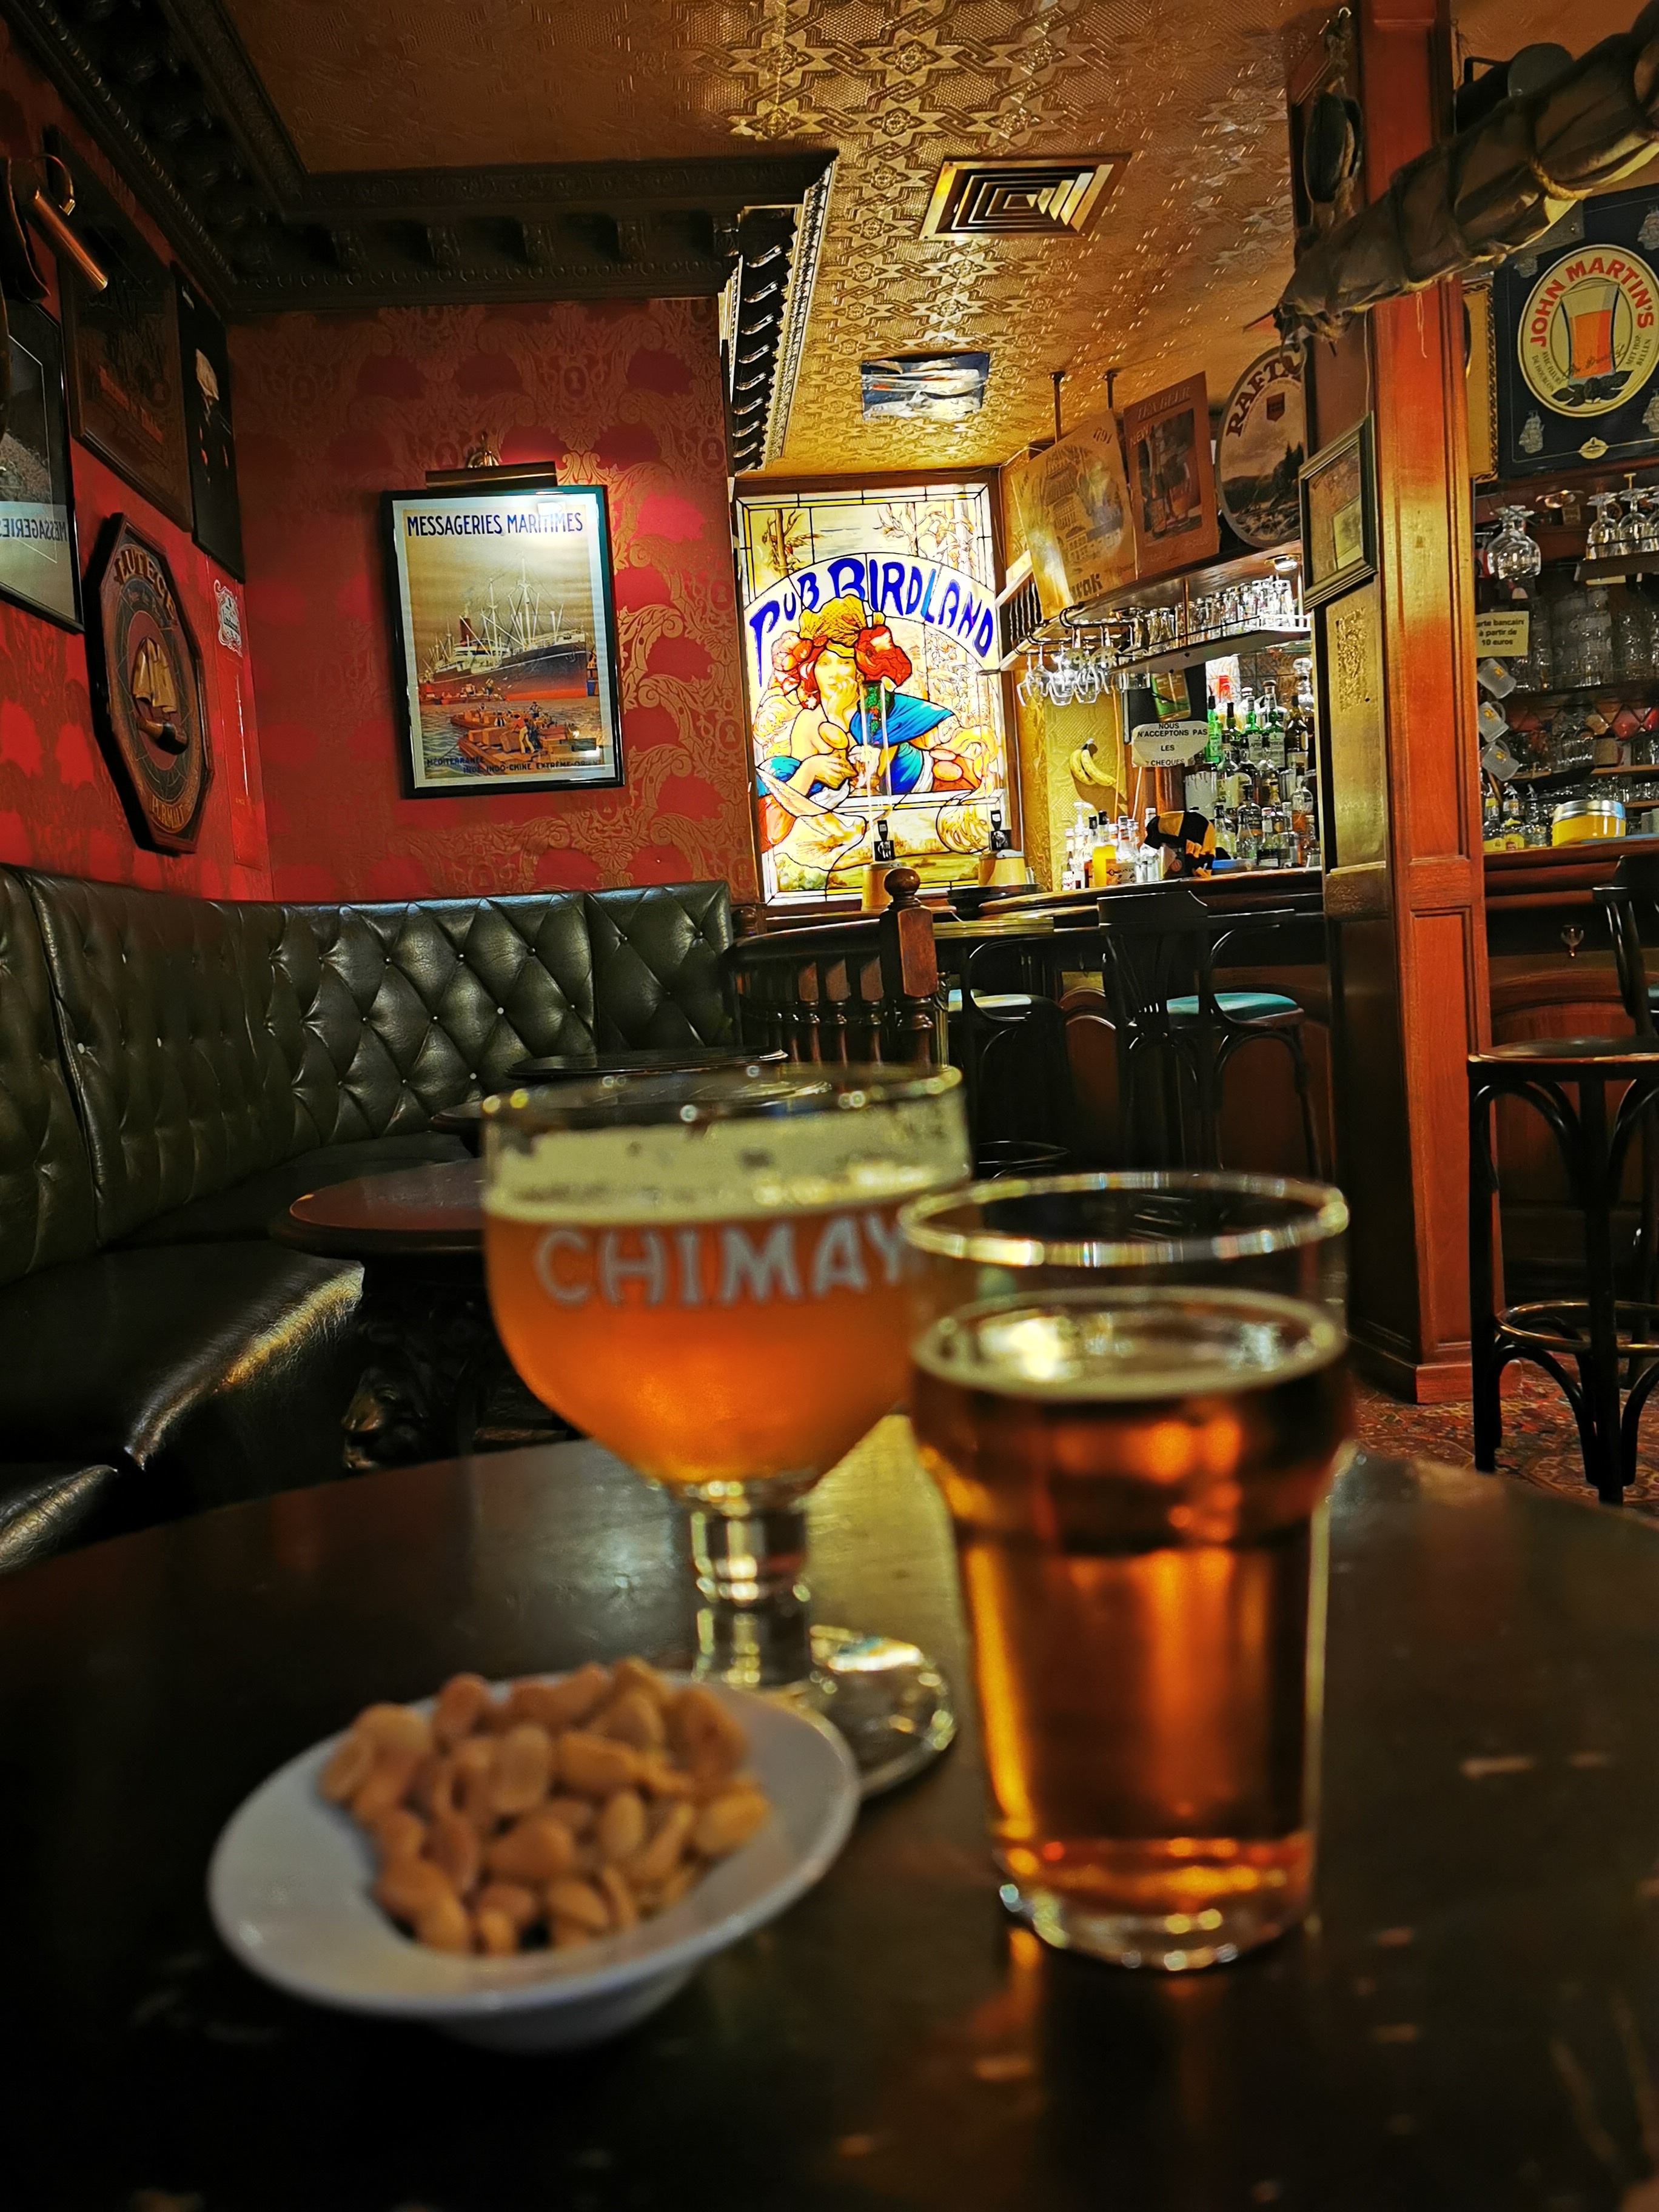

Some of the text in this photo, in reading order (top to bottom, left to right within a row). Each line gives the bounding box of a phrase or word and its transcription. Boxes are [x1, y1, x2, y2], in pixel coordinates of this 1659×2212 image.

[1530, 257, 1654, 347] JOHN MARTIN'S
[1129, 424, 1151, 449] NEW
[407, 512, 583, 536] MESSAGERIES MARITIMES
[749, 557, 994, 687] PUB BIRDLAND
[534, 1213, 907, 1307] CHIMAY
